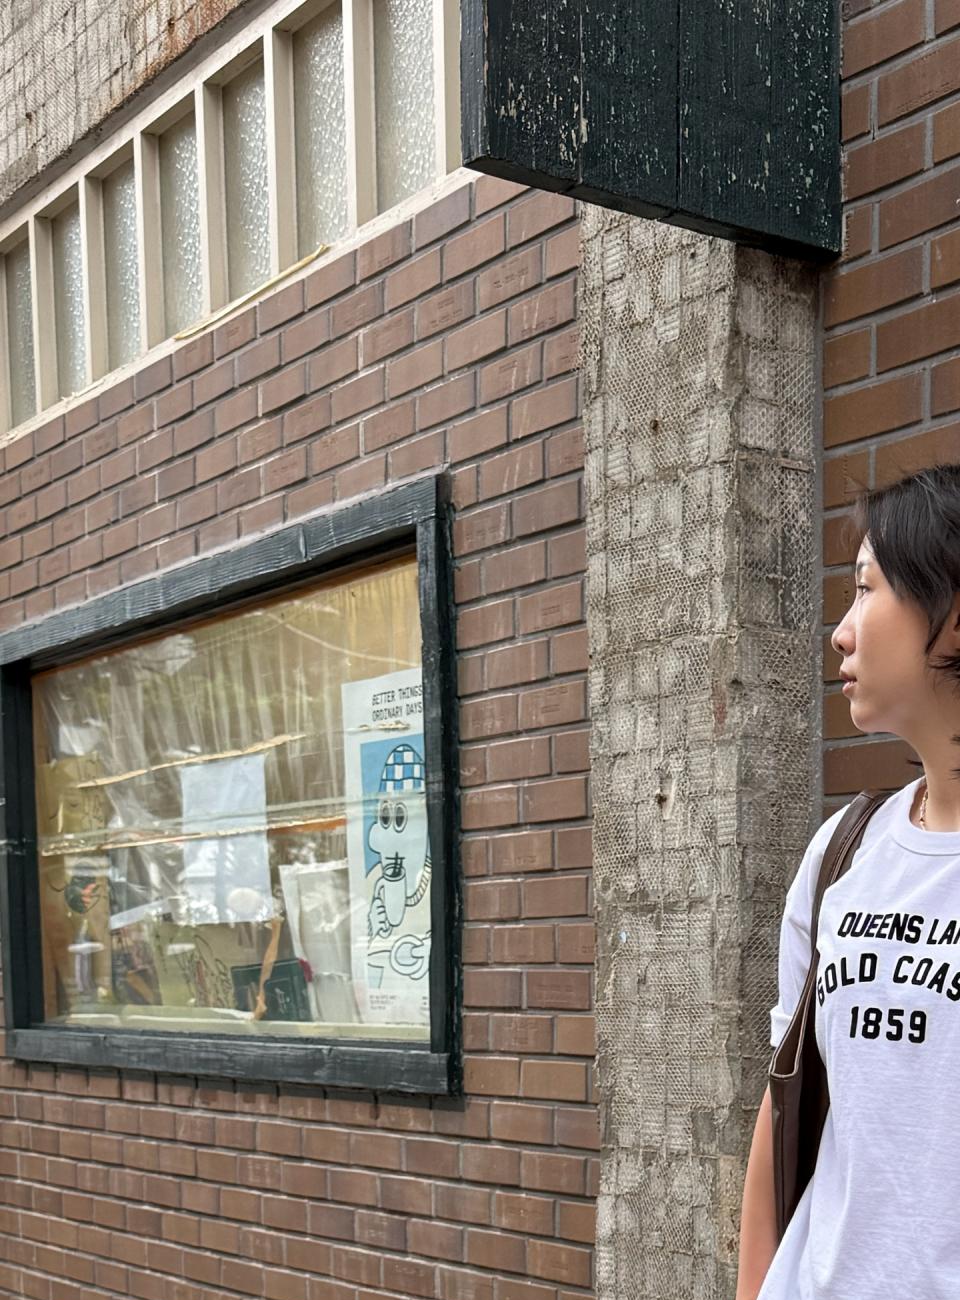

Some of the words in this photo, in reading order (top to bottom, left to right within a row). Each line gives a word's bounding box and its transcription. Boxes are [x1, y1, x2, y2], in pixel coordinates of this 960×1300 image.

[372, 690, 395, 706] BETTER
[398, 684, 423, 700] THINGS
[372, 705, 402, 721] ORDINARY
[406, 702, 423, 715] DAYS
[837, 911, 925, 944] QUEENS
[817, 953, 878, 1007] GOLD
[849, 1006, 927, 1044] 1859
